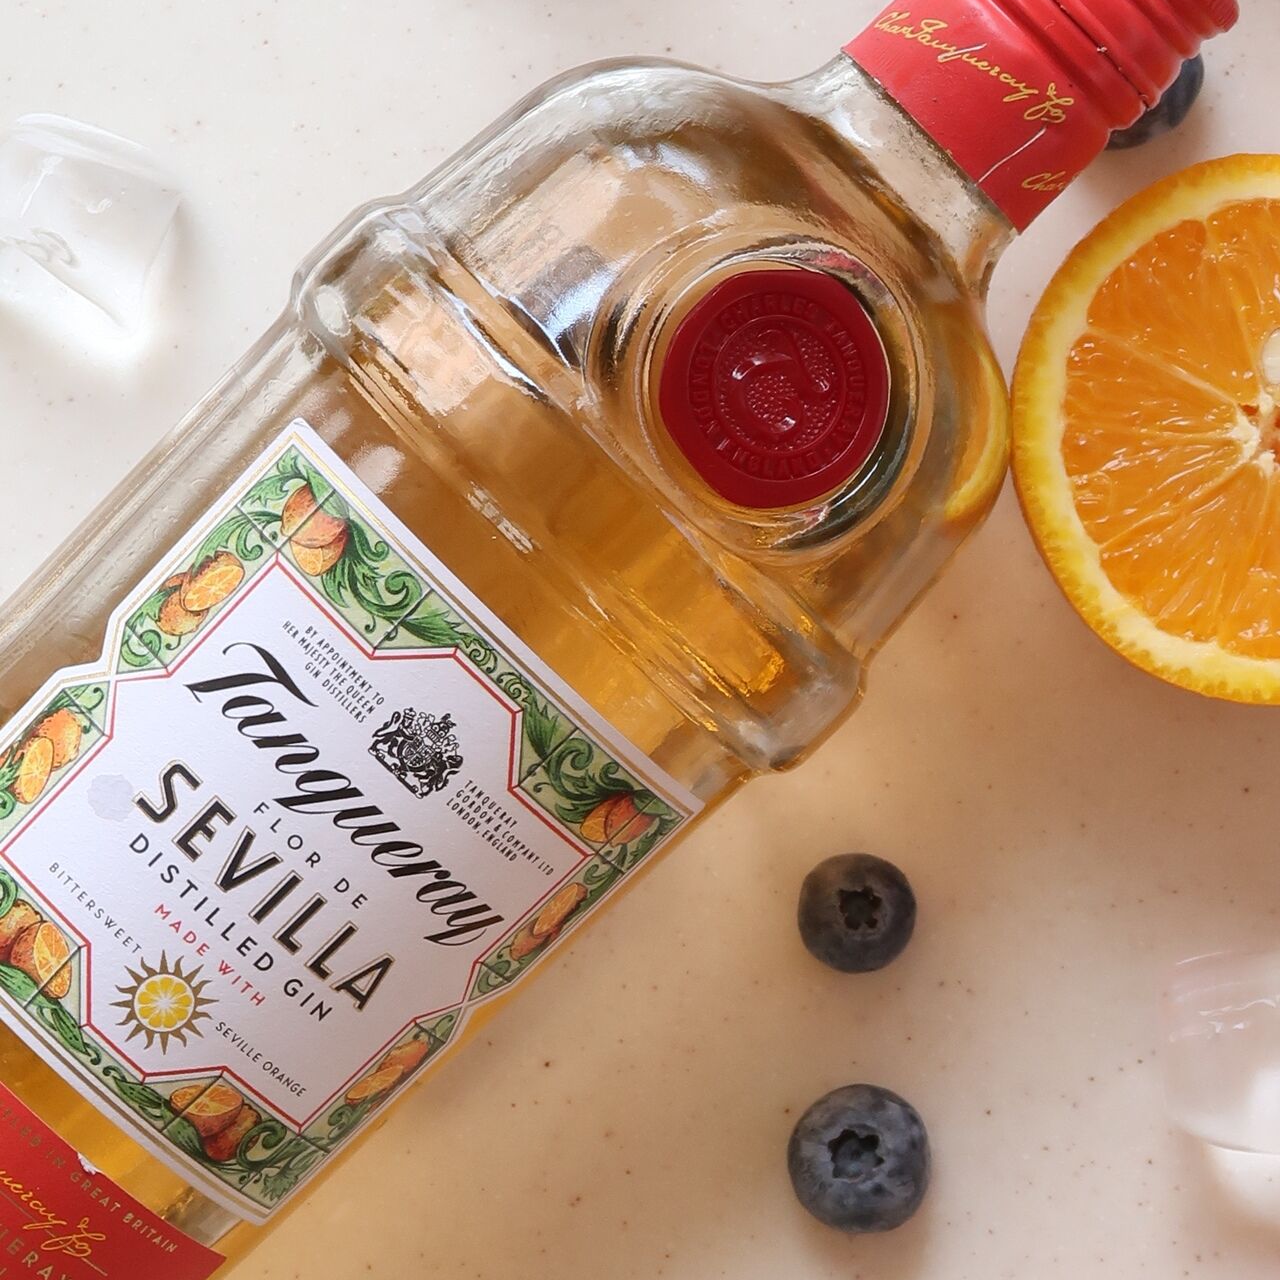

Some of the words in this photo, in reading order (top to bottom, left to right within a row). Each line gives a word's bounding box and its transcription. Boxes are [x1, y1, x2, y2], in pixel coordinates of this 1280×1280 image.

[282, 621, 299, 639] HER
[298, 637, 331, 669] MAJESTY
[329, 667, 347, 686] THE
[346, 685, 375, 714] QUEEN
[305, 626, 318, 638] BY
[316, 639, 373, 693] APPOINTMENT
[372, 692, 385, 705] TO
[305, 662, 322, 679] GIN
[322, 678, 367, 723] DISTILLERS
[185, 643, 505, 947] Tanqueray
[456, 789, 494, 825] GORDON
[493, 824, 502, 833] &
[502, 831, 540, 863] COMPANY
[537, 861, 554, 876] LTD
[465, 780, 518, 828] TANQUERAY
[133, 760, 395, 1012] SEVILLA
[253, 802, 321, 868] FLOR
[333, 877, 368, 909] DE
[481, 830, 517, 861] ENGLAND
[129, 833, 274, 972] DISTILLED
[283, 979, 333, 1021] GIN
[154, 904, 210, 957] MADE
[218, 960, 266, 1006] WITH
[49, 862, 142, 954] BITTERSWEET
[215, 1022, 263, 1063] SEVILLE
[262, 1060, 307, 1097] ORANGE
[69, 1170, 122, 1214] GREAT
[123, 1213, 178, 1253] BRITAIN
